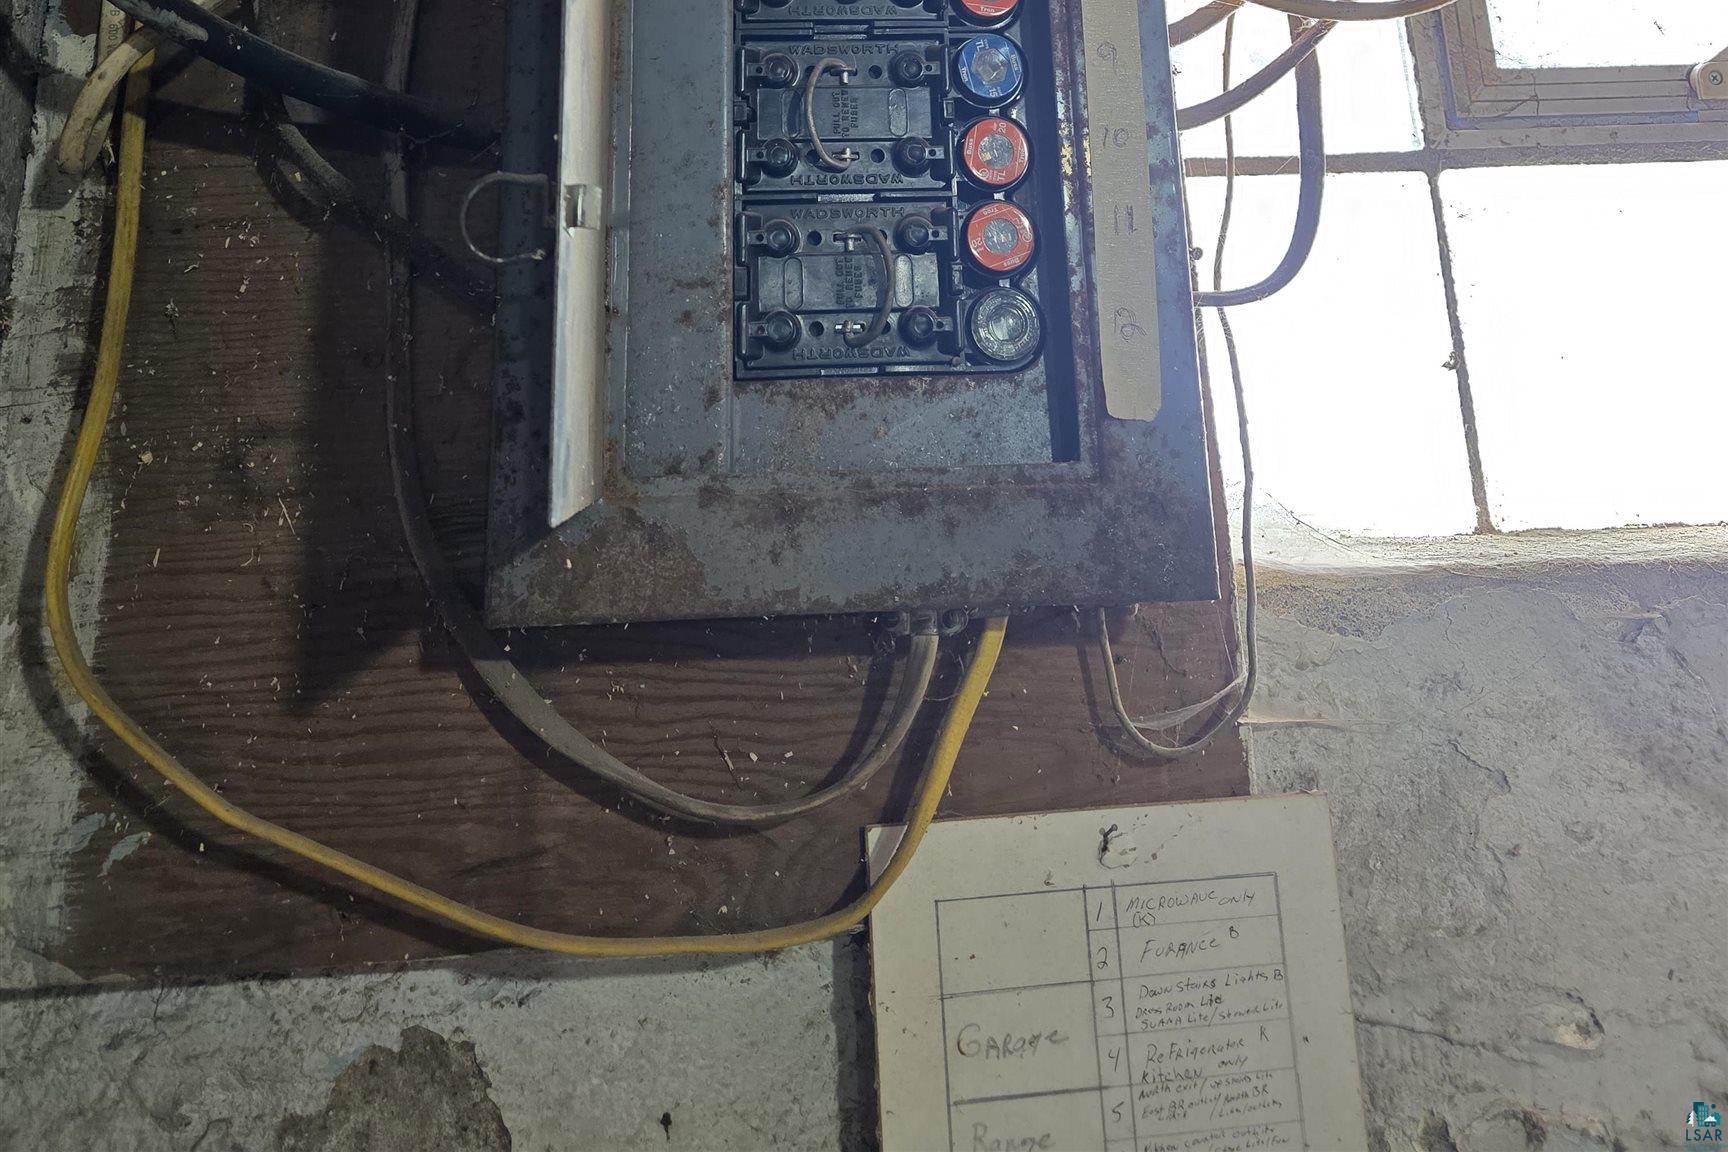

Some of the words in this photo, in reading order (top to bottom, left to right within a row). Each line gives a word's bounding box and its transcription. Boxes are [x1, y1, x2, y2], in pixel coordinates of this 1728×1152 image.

[789, 44, 899, 56] WADSWORTH
[1097, 41, 1118, 76] 9
[999, 121, 1008, 134] 20
[1103, 125, 1130, 149] 10
[790, 173, 905, 186] WADSWORTH
[789, 207, 906, 219] WADSWORTH
[1113, 204, 1137, 236] 11
[971, 238, 982, 249] 20
[1096, 901, 1102, 923] 1
[1096, 946, 1109, 969] 2
[1101, 995, 1115, 1019] 3
[1108, 1047, 1121, 1073] 4
[1111, 1100, 1125, 1122] 5
